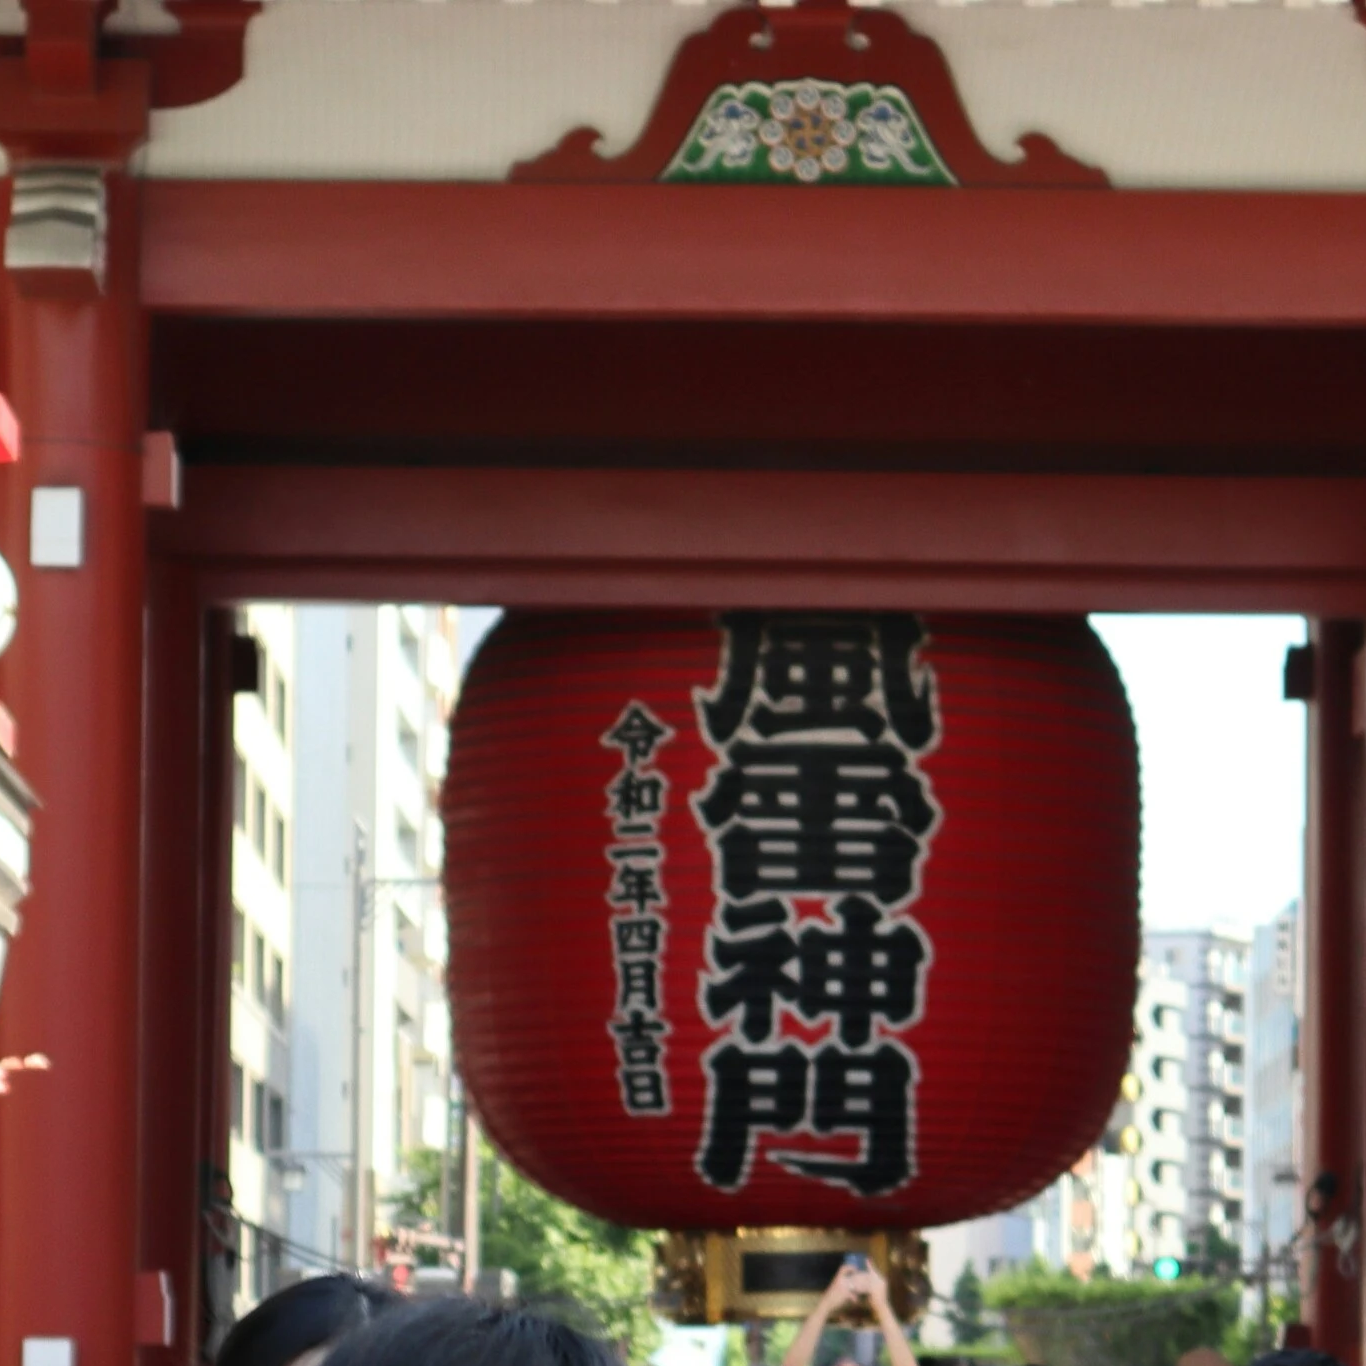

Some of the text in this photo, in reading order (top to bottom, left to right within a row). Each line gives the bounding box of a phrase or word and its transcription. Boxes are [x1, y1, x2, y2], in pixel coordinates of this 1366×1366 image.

[601, 699, 676, 1118] 令和二年四月吉日
[691, 610, 943, 1196] 風雷神門
